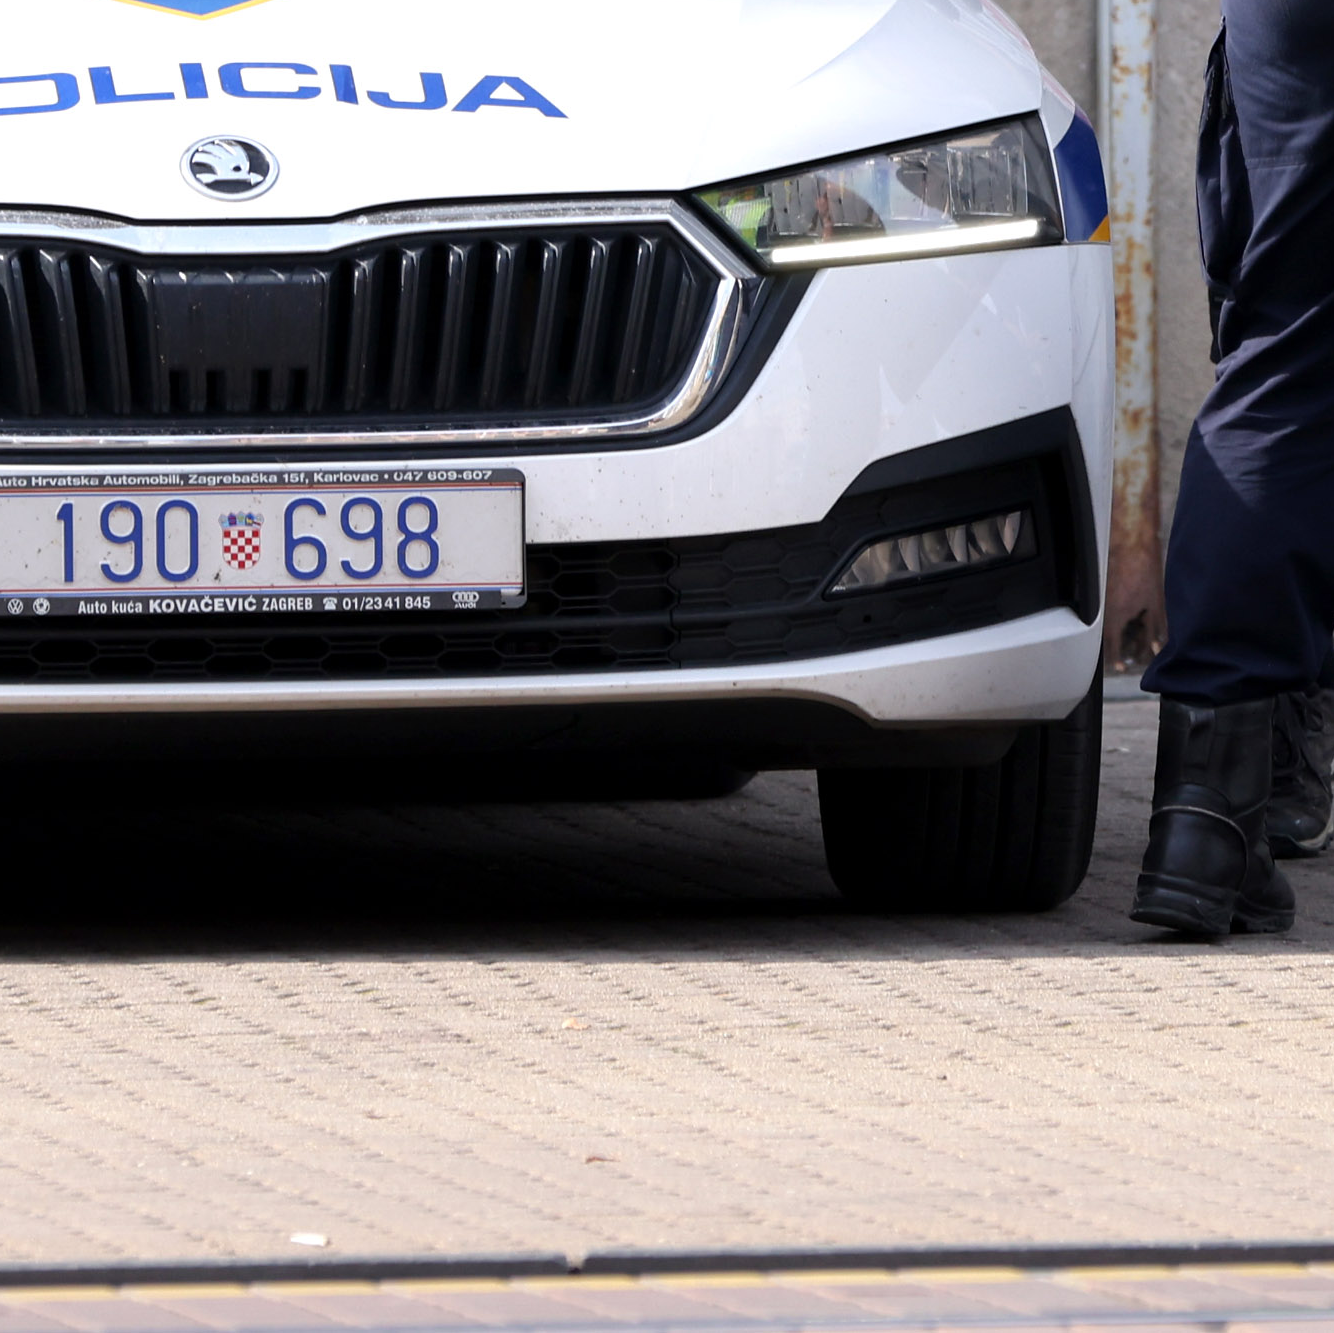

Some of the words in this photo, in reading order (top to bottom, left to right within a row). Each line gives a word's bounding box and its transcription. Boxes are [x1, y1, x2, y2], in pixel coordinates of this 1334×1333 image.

[31, 475, 99, 487] Hrvatska
[103, 474, 184, 486] Automobili,
[188, 472, 278, 488] Zagrebačka
[313, 470, 379, 482] Karlovac
[393, 470, 423, 482] 047
[55, 499, 199, 583] 190
[283, 495, 440, 581] 698
[78, 600, 107, 614] Auto
[112, 599, 143, 614] kuća
[149, 595, 257, 614] KOVAČEVIĆ
[262, 597, 313, 611] ZAGREB
[404, 595, 431, 610] 845
